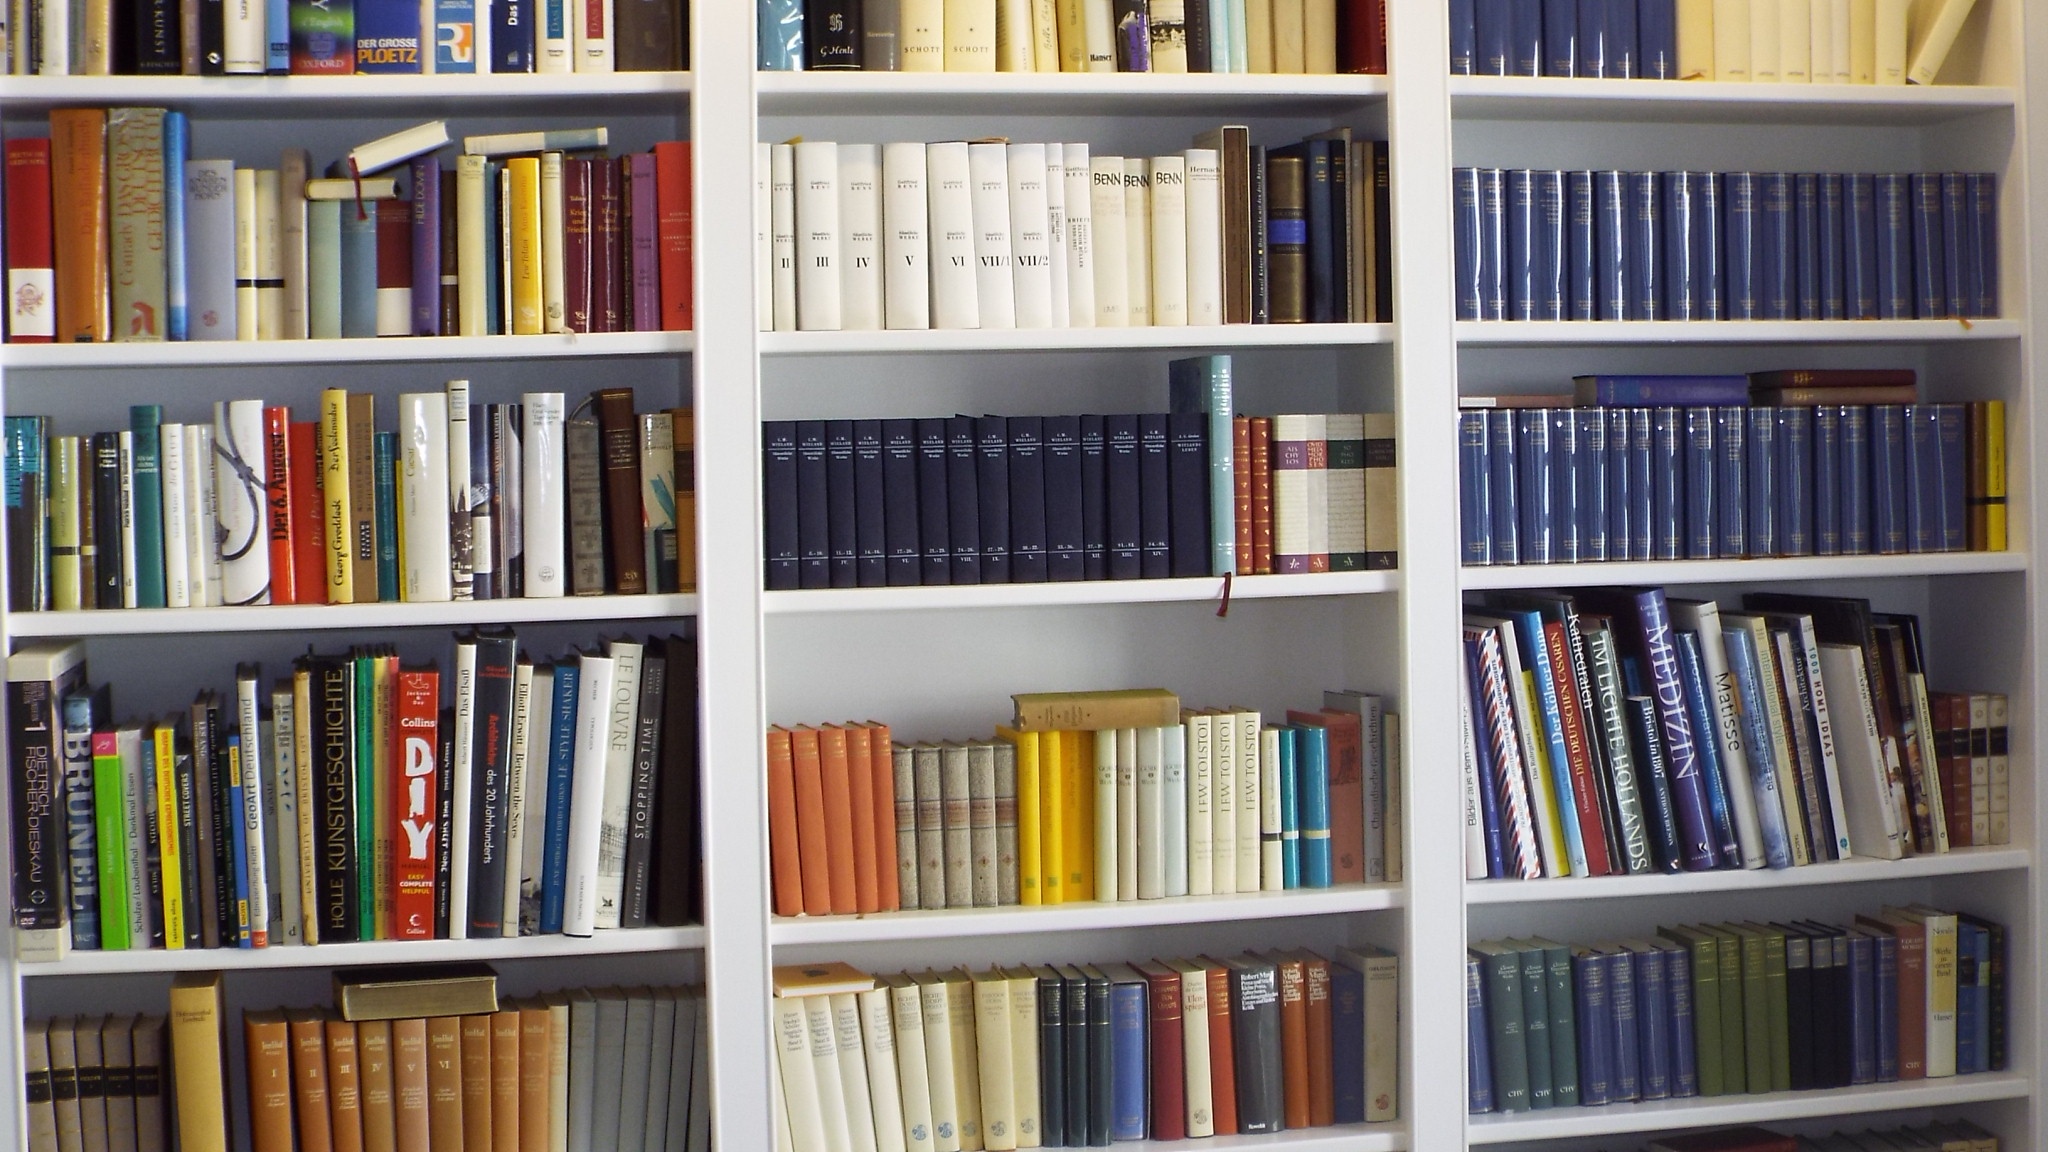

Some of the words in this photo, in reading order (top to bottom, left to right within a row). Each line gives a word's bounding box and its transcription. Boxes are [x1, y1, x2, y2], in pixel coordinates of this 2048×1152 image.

[508, 5, 518, 26] Das
[154, 10, 165, 54] KUNST
[357, 40, 377, 49] DER
[378, 39, 417, 50] GROSSE
[357, 49, 418, 64] PLOETZ
[1090, 54, 1112, 62] Hanser
[416, 165, 425, 200] DOMIN
[1094, 172, 1121, 186] BENN
[1124, 174, 1150, 188] BENN
[1156, 171, 1182, 185] BENN
[416, 201, 425, 225] HILDE
[119, 222, 134, 287] Conrady
[781, 258, 790, 268] II
[816, 257, 829, 267] III
[856, 257, 870, 268] IV
[905, 256, 914, 266] V
[951, 256, 966, 267] VI
[981, 256, 1010, 267] VII/1
[1018, 255, 1049, 267] VII/2
[268, 432, 287, 491] August
[406, 447, 416, 478] Caesar
[269, 492, 288, 509] 6.
[270, 511, 289, 541] Der
[332, 548, 347, 587] Georg
[1537, 628, 1551, 669] Dom
[1567, 613, 1593, 710] Kathedralen
[1591, 639, 1609, 666] IM
[618, 654, 634, 674] LE
[459, 669, 470, 696] Elsaß
[519, 683, 528, 712] Elliott
[562, 673, 574, 721] SHAKER
[1492, 659, 1505, 708] JAHRHUNDERTS
[1543, 669, 1560, 716] Kölner
[1796, 656, 1811, 712] Architektur
[460, 698, 469, 718] Das
[1597, 667, 1626, 751] LICHTE
[1646, 623, 1699, 781] MEDIZIN
[1690, 655, 1706, 699] frozen
[1699, 708, 1717, 756] planet
[1714, 671, 1740, 752] Matisse
[1761, 650, 1780, 718] international
[1771, 719, 1785, 746] style
[1808, 647, 1819, 675] 1000
[1814, 680, 1826, 713] HOME
[1821, 720, 1833, 758] IDEAS
[25, 721, 46, 732] 1
[401, 717, 435, 729] Collins
[518, 715, 527, 745] Erwitt
[611, 681, 632, 752] LOUVRE
[1560, 684, 1582, 753] DEUTSCHEN
[242, 698, 255, 780] Deutschland
[487, 713, 499, 766] Architektur
[559, 726, 571, 761] STYLE
[641, 717, 654, 756] TIME
[1369, 705, 1381, 768] Geschichten
[1551, 719, 1565, 745] Der
[1643, 706, 1657, 744] Bristol
[1652, 756, 1665, 779] 1807
[1197, 722, 1209, 781] TOLSTOI
[1221, 721, 1231, 779] TOLSTOI
[1245, 719, 1256, 778] TOLSTOI
[1464, 752, 1472, 774] dem
[324, 668, 346, 872] KUNSTGESCHICHTE
[486, 769, 497, 787] des
[514, 753, 525, 793] Between
[558, 763, 567, 779] LE
[1573, 755, 1584, 777] DIE
[36, 746, 49, 817] DIETRICH
[126, 772, 135, 797] Essen
[182, 773, 190, 801] COVERS
[24, 746, 42, 884] FISCHER-DIESKAU
[183, 801, 191, 827] STREET
[244, 785, 257, 830] GeoArt
[513, 795, 522, 811] the
[634, 760, 650, 840] STOPPING
[1468, 799, 1477, 826] Bilder
[1613, 754, 1648, 871] HOLLANDS
[1659, 786, 1669, 818] ANTHONY
[64, 728, 96, 911] BRUNEL
[128, 799, 138, 839] Denkmal
[511, 812, 521, 839] Sexes
[483, 804, 496, 865] Jahrhunderts
[400, 880, 433, 888] COMPLETE
[402, 887, 430, 895] HELPFUL
[329, 878, 345, 929] HOLLE
[1240, 973, 1258, 982] Robert
[340, 1065, 351, 1074] III
[439, 1060, 450, 1069] VI
